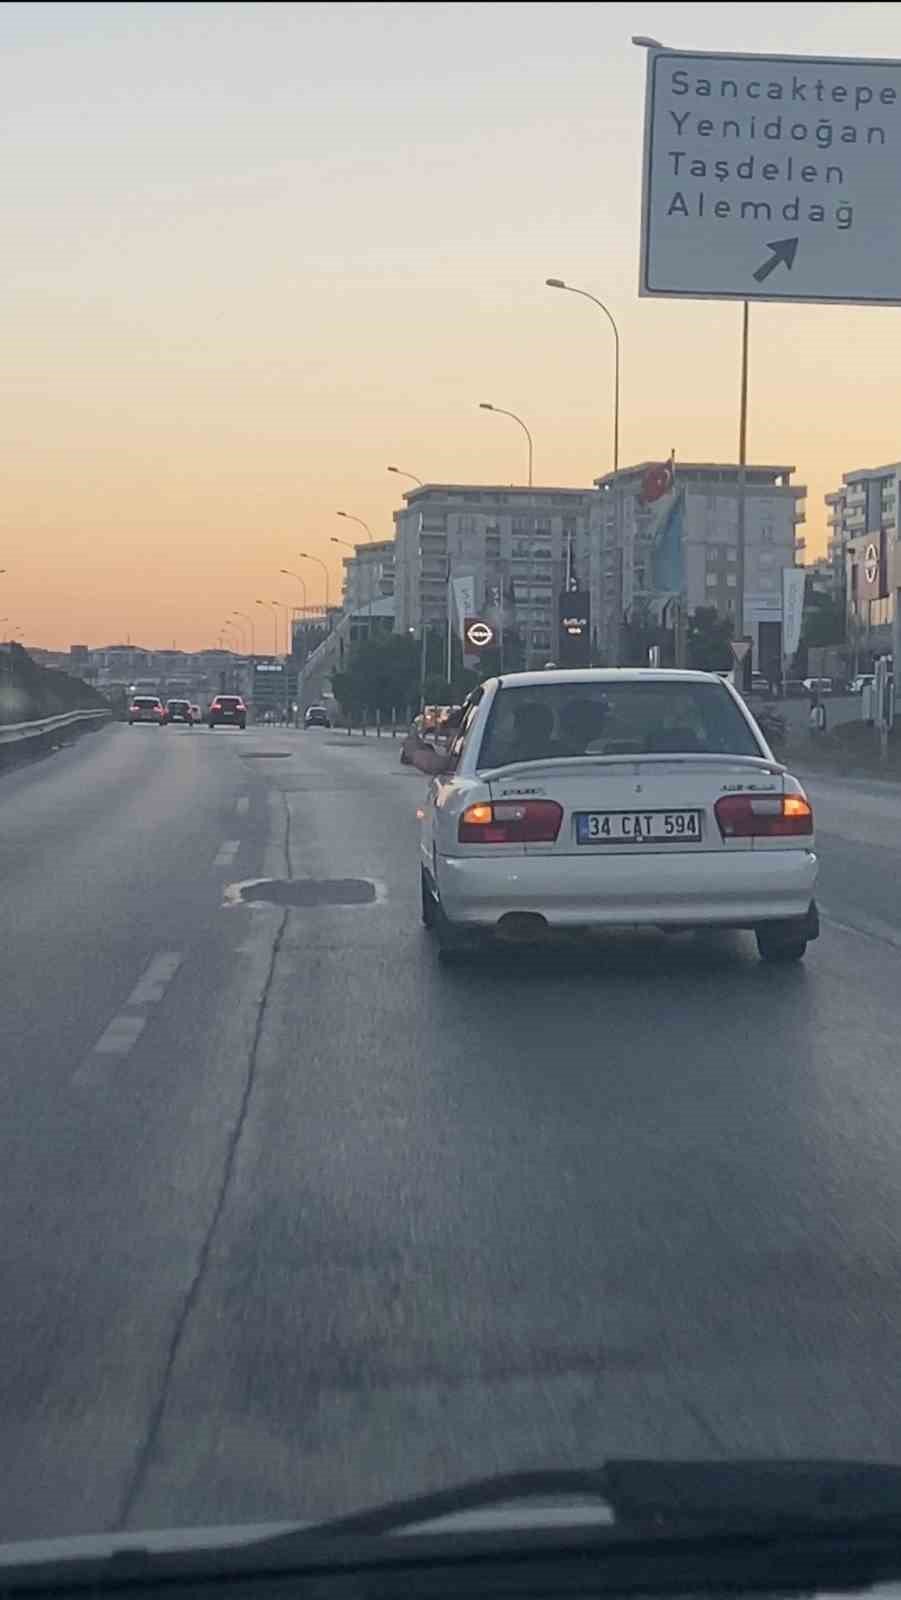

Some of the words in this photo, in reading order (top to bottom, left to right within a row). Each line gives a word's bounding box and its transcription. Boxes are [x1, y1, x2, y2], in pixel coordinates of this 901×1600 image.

[671, 70, 897, 111] Sancaktepe
[668, 110, 886, 149] Yenidoğan
[668, 152, 844, 184] Taşdelen
[667, 191, 853, 230] Alemdağ
[590, 816, 610, 836] 34
[621, 815, 653, 836] CAT
[664, 814, 697, 834] 594
